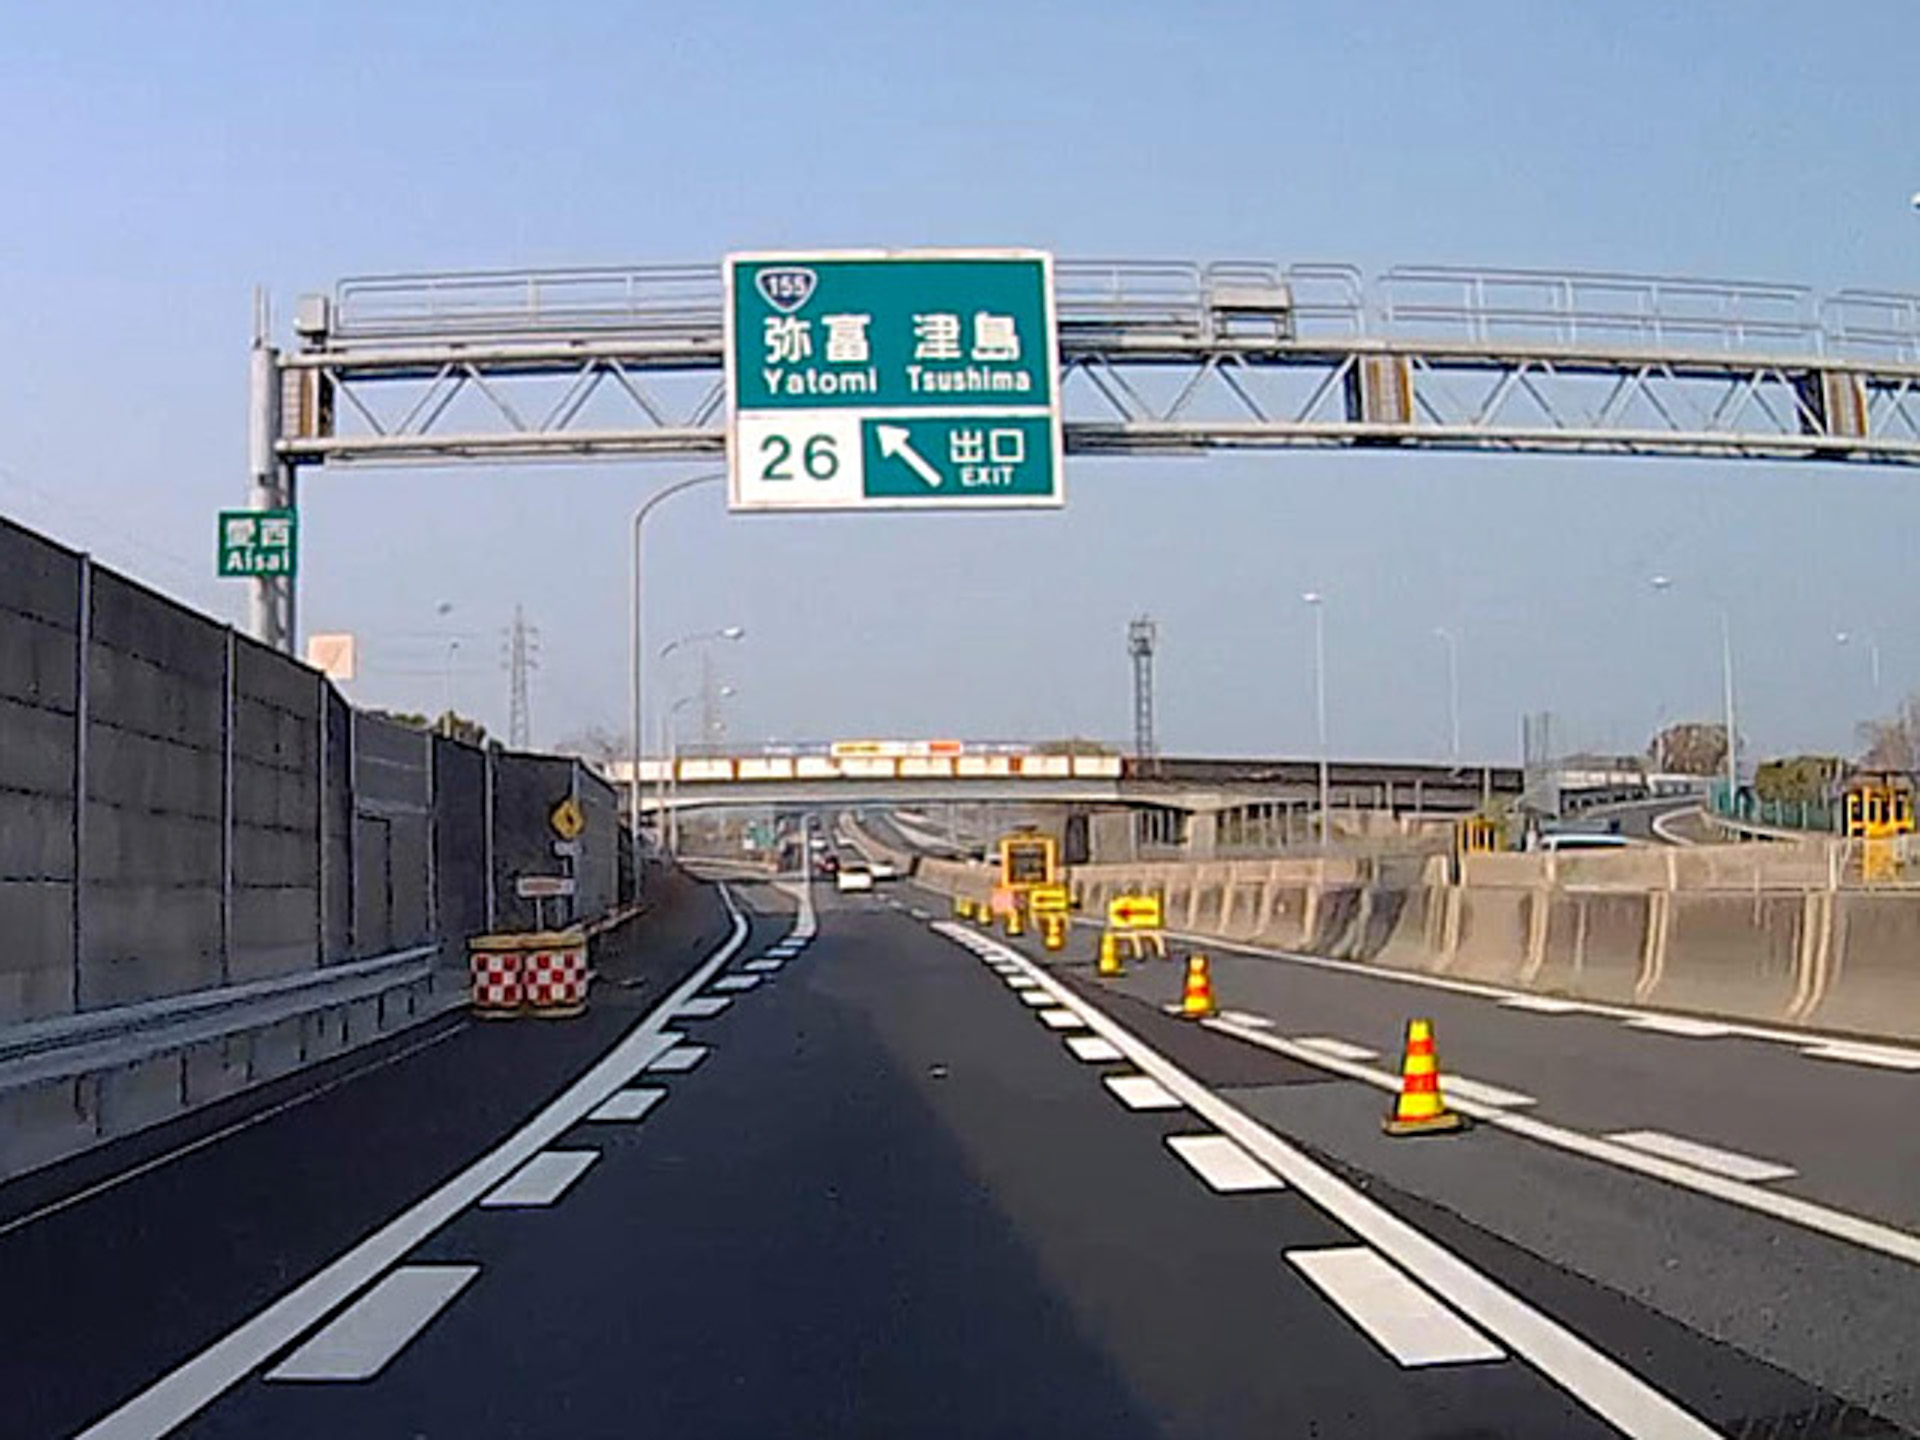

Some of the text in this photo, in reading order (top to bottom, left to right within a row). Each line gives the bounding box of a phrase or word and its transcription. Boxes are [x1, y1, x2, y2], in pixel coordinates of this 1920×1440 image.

[764, 311, 1020, 363] 弥富 津島
[763, 366, 1031, 395] Yatomi Tsushima
[760, 434, 839, 481] 26
[950, 429, 1024, 463] 出口
[961, 467, 1015, 487] EXIT
[227, 548, 290, 571] Aisai
